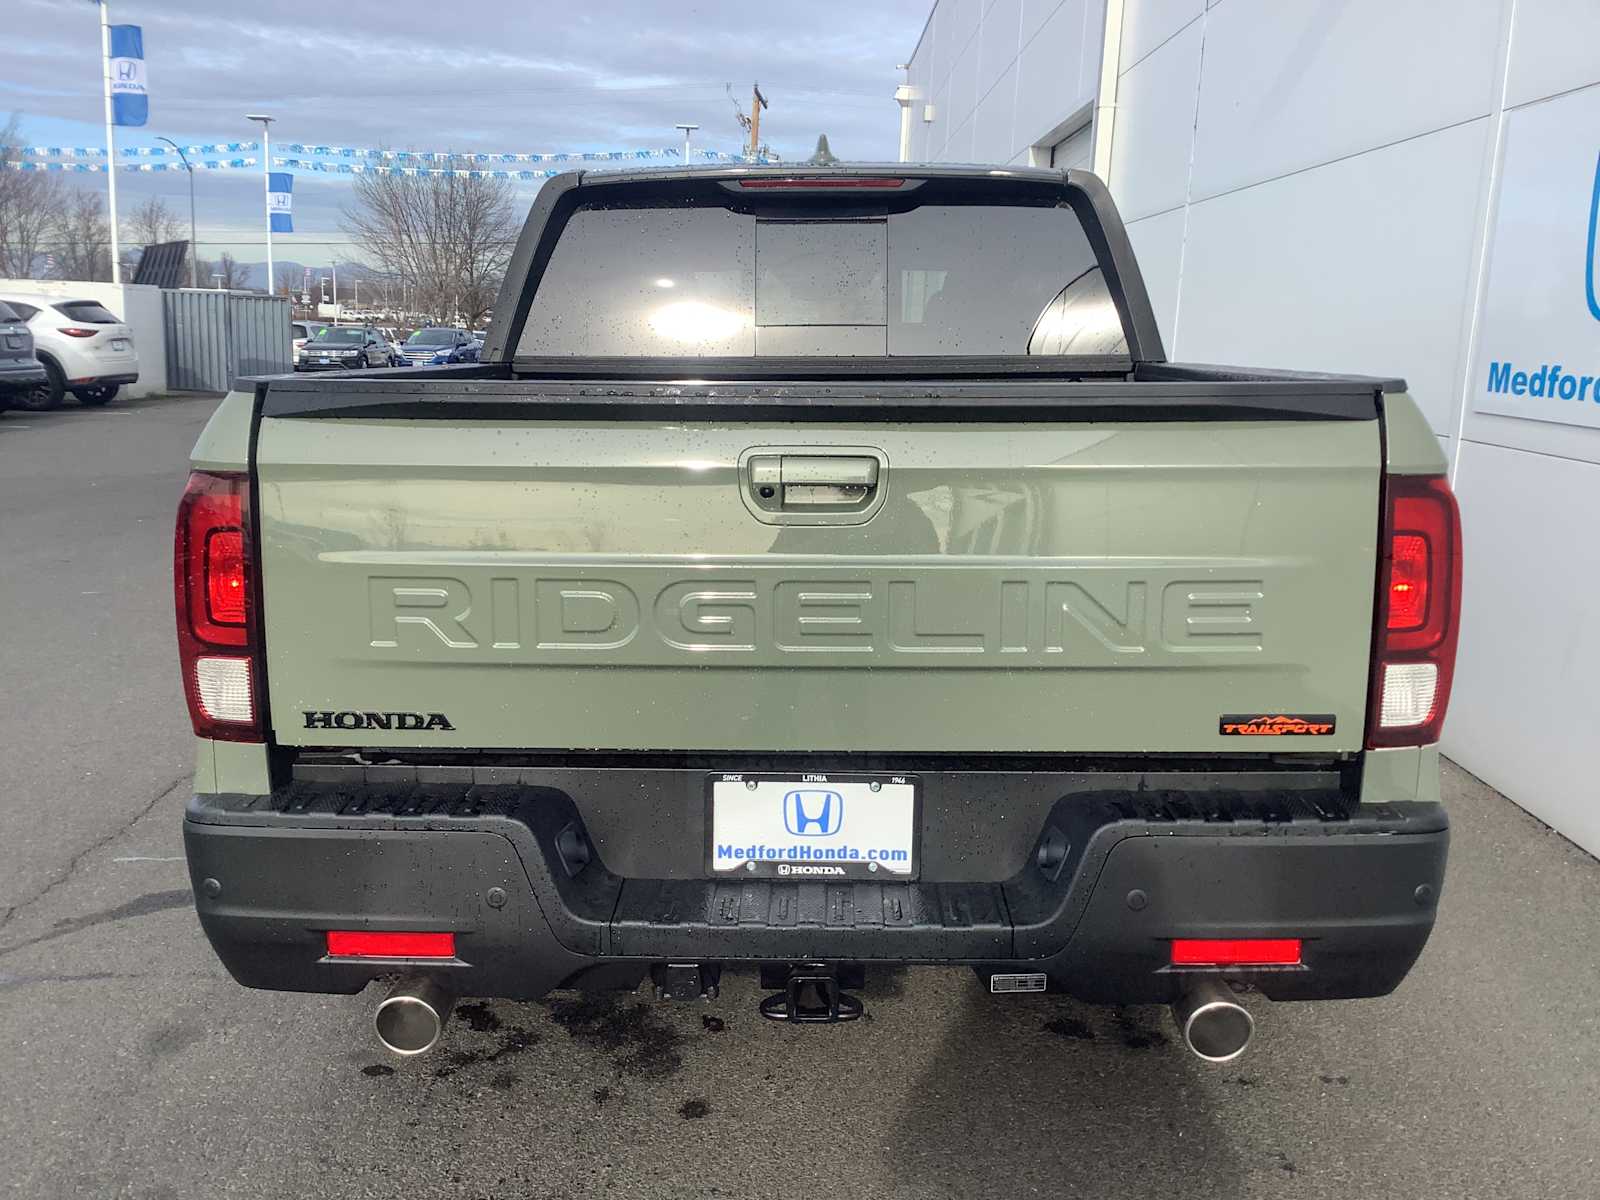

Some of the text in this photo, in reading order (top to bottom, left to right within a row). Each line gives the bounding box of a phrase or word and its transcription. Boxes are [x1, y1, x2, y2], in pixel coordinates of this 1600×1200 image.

[368, 576, 1264, 655] RIDGELINE
[302, 711, 456, 730] HONDA
[1223, 724, 1333, 734] TRAILSPORT
[722, 774, 743, 782] SINCE
[802, 774, 827, 783] LITHIA
[717, 844, 908, 861] MedfordHonda.com
[791, 866, 845, 875] HONDA
